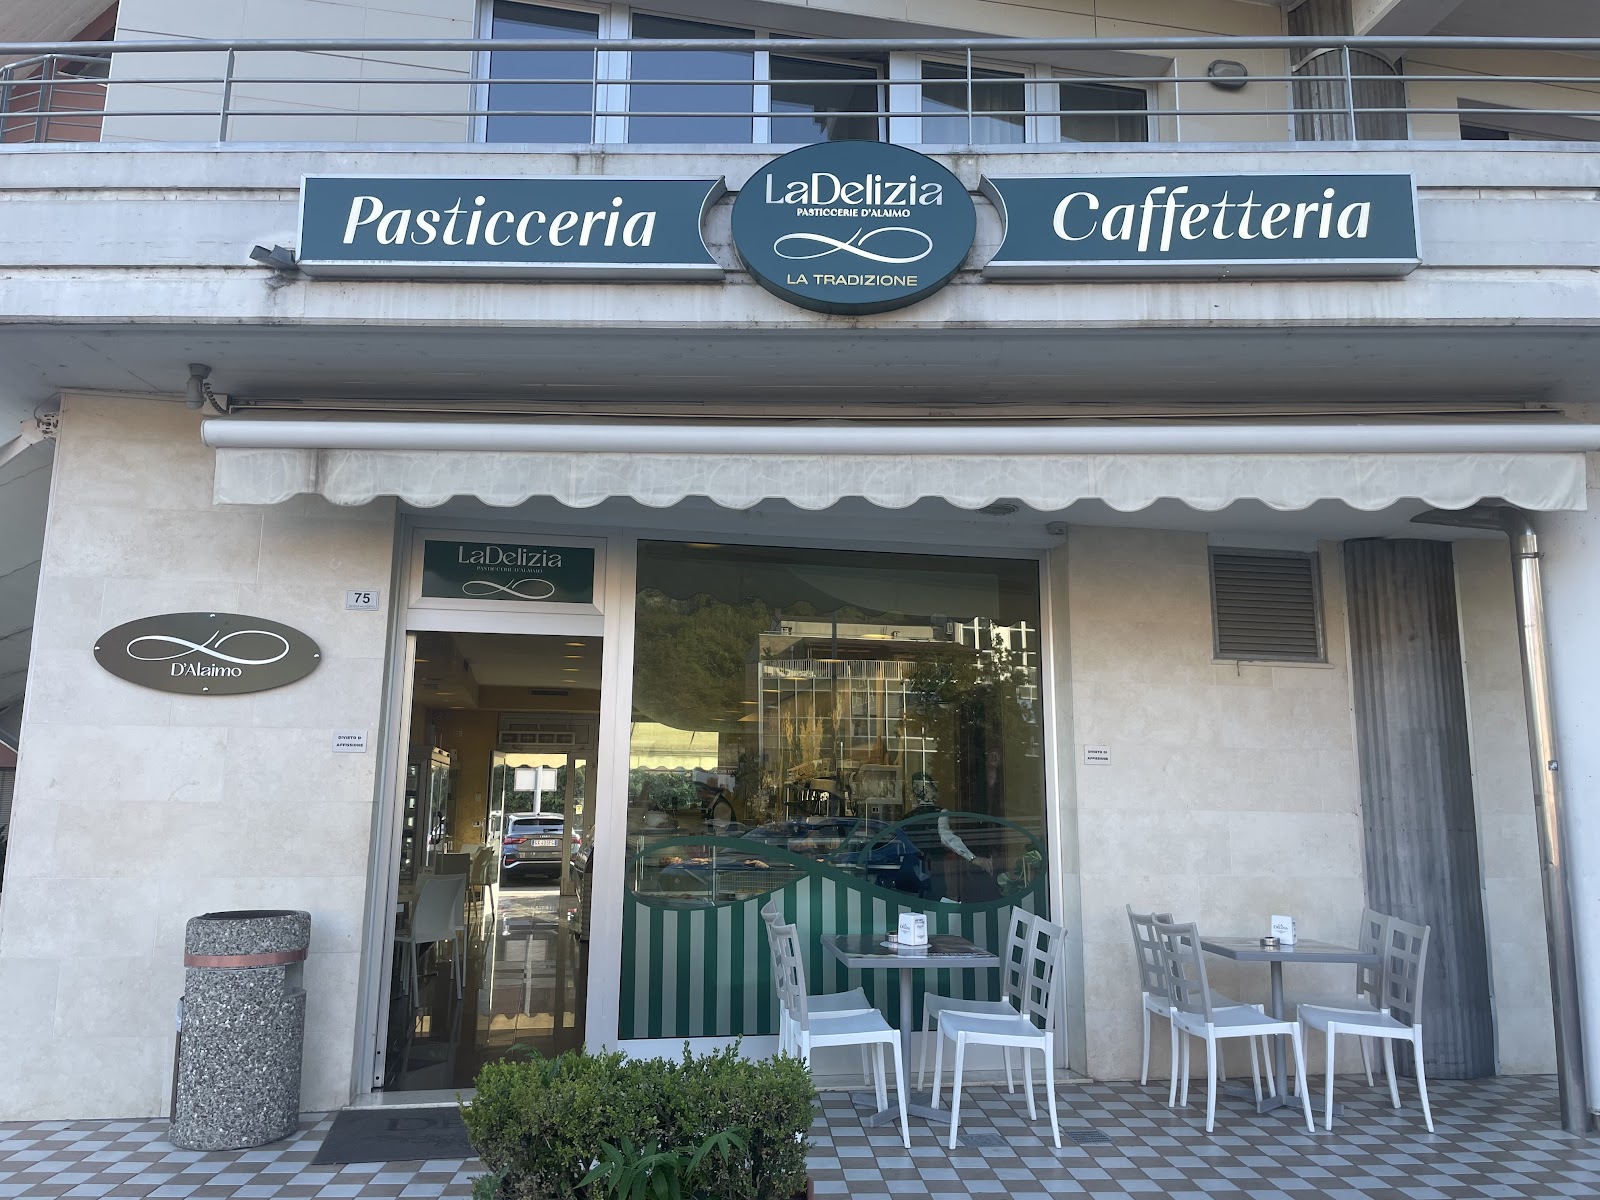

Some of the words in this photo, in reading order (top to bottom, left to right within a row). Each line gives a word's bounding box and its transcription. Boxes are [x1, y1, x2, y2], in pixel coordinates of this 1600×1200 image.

[765, 172, 943, 206] LaDelizia
[343, 195, 657, 247] Pasticceria
[796, 208, 859, 217] PASTICCERIE
[861, 208, 911, 218] D'ALAIMO
[1052, 185, 1371, 252] Caffetteria
[787, 274, 809, 285] LA
[813, 274, 918, 287] TRADIZIONE
[354, 592, 371, 604] 75
[170, 662, 242, 678] D'Alaimo
